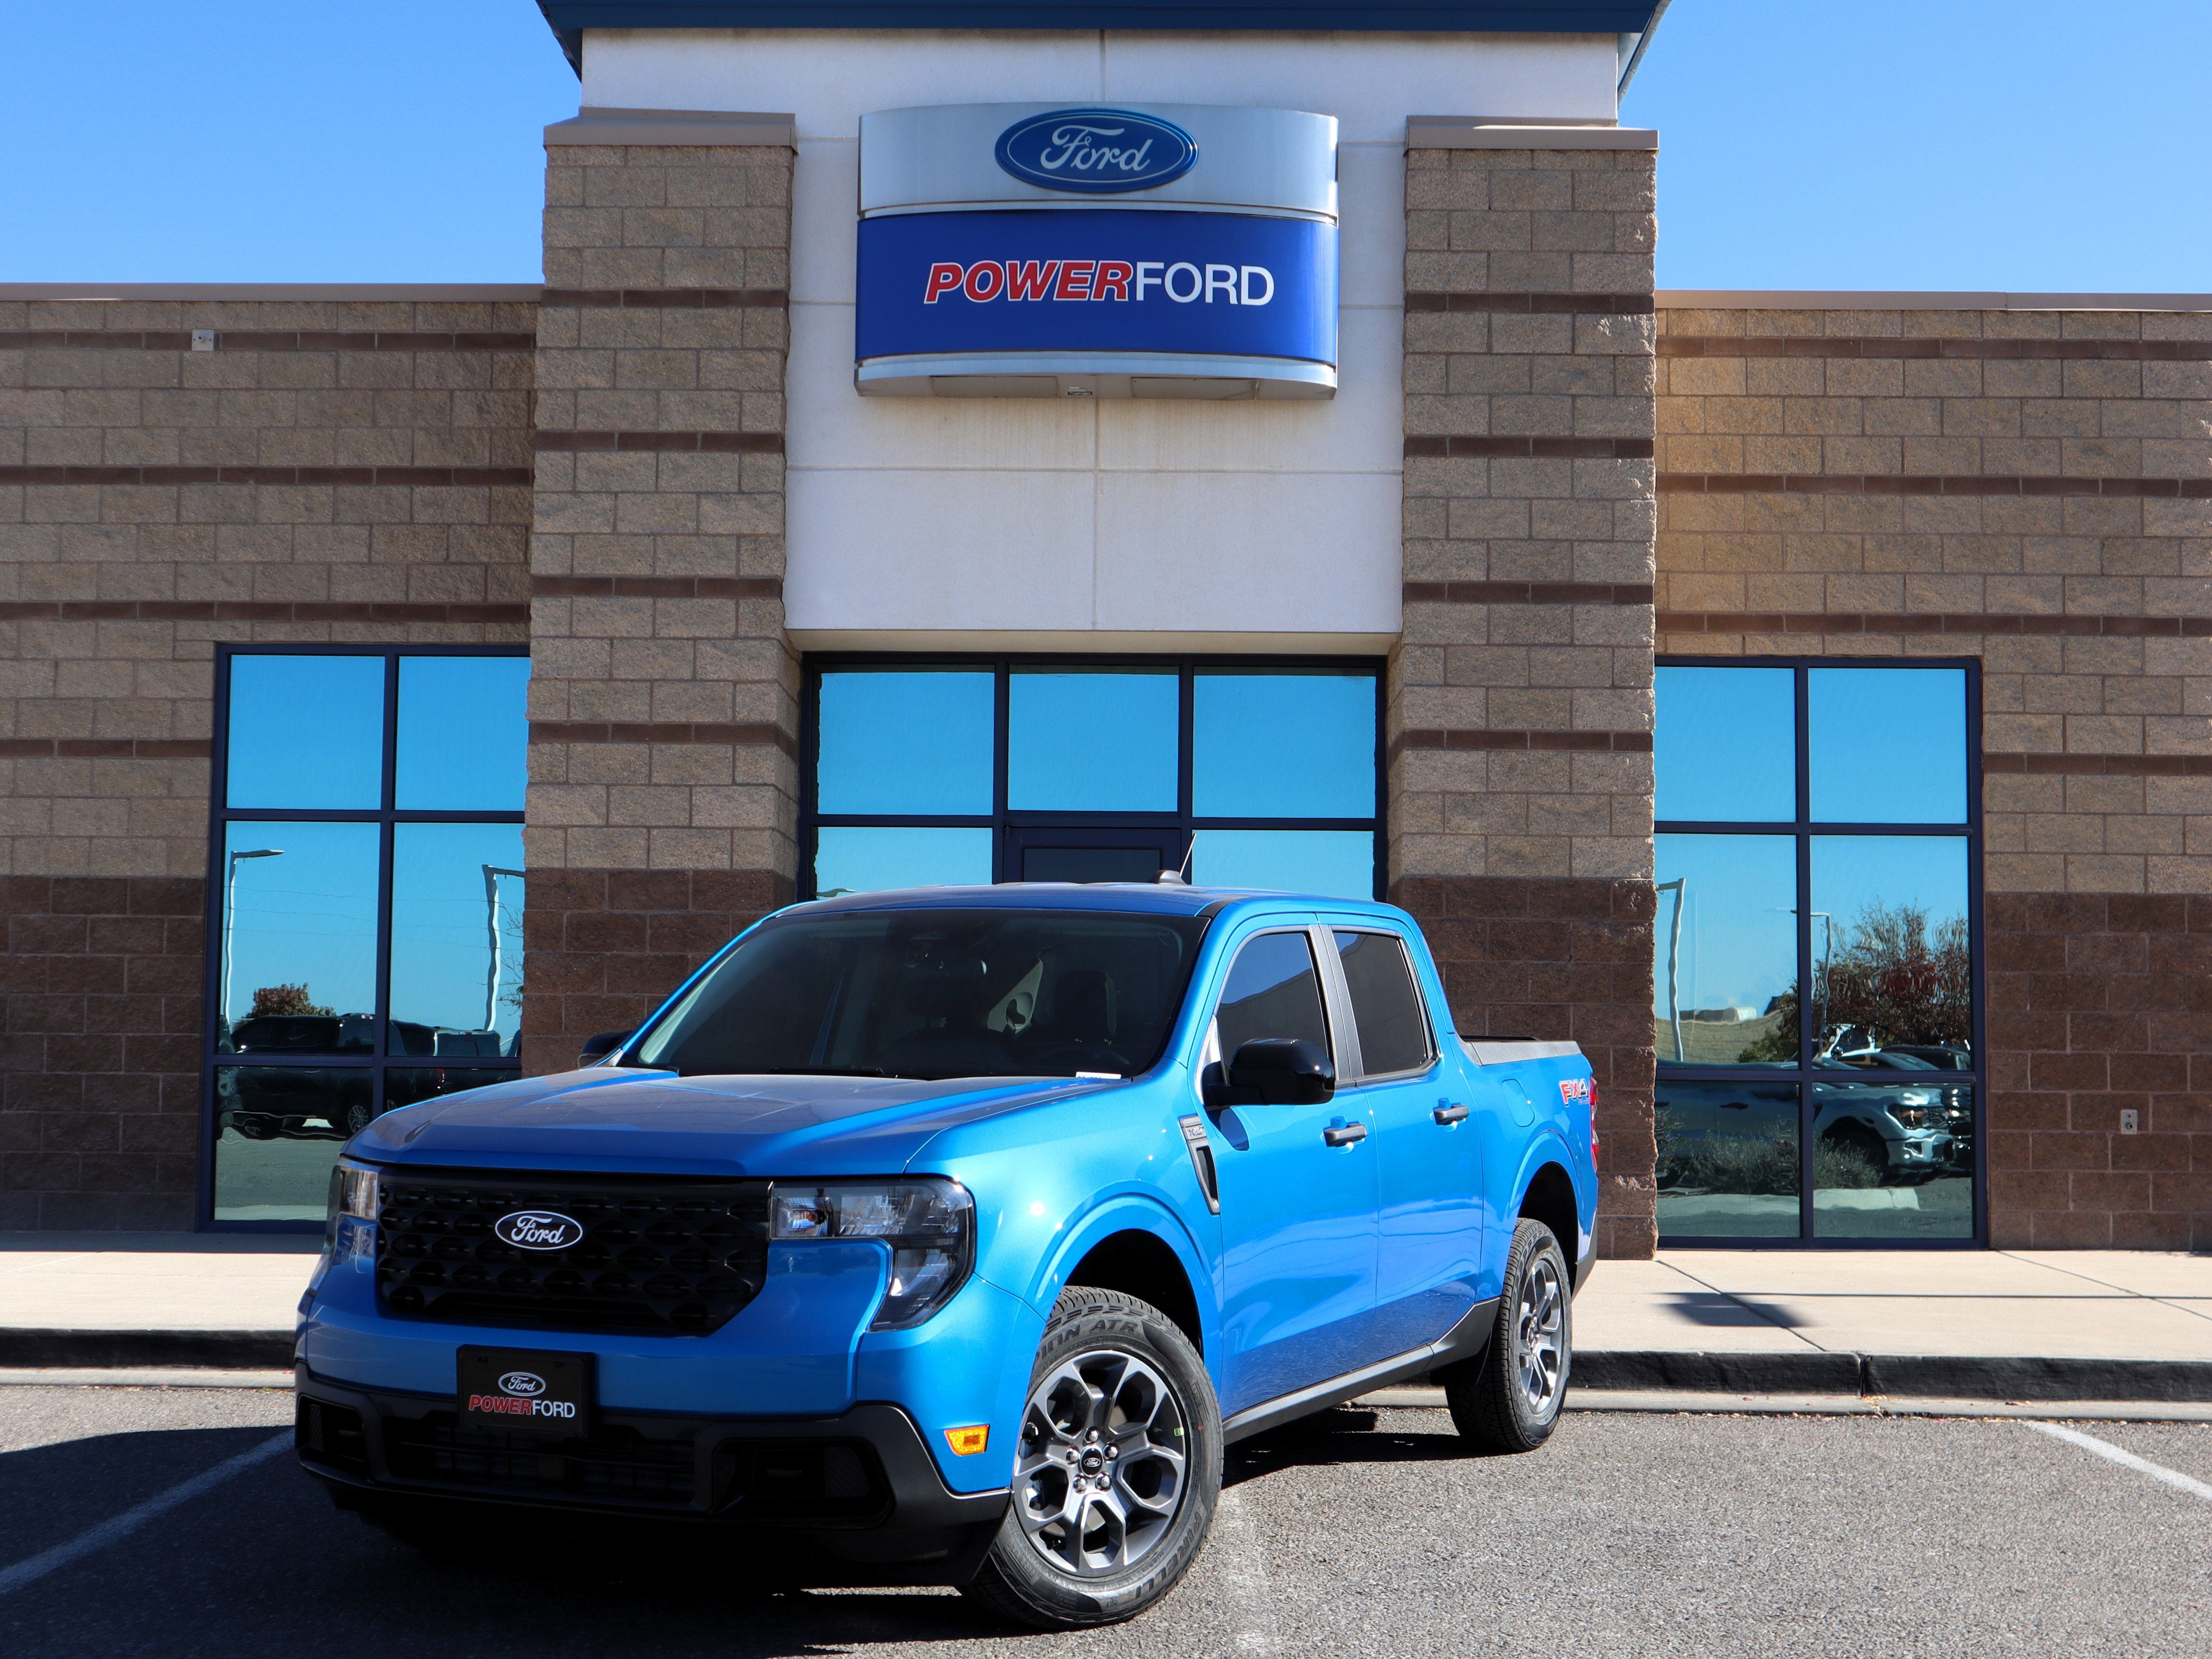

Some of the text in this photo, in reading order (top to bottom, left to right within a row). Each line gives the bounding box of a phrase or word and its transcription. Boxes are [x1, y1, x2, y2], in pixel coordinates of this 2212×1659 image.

[1040, 124, 1154, 171] Ford
[923, 260, 1275, 306] POWERFORD
[1559, 1078, 1590, 1107] FX4
[510, 1215, 566, 1244] Ford
[1089, 1319, 1139, 1334] ATR
[508, 1375, 537, 1392] Ford
[468, 1394, 576, 1418] POWERFORD
[1135, 1511, 1202, 1599] PIRELLI
